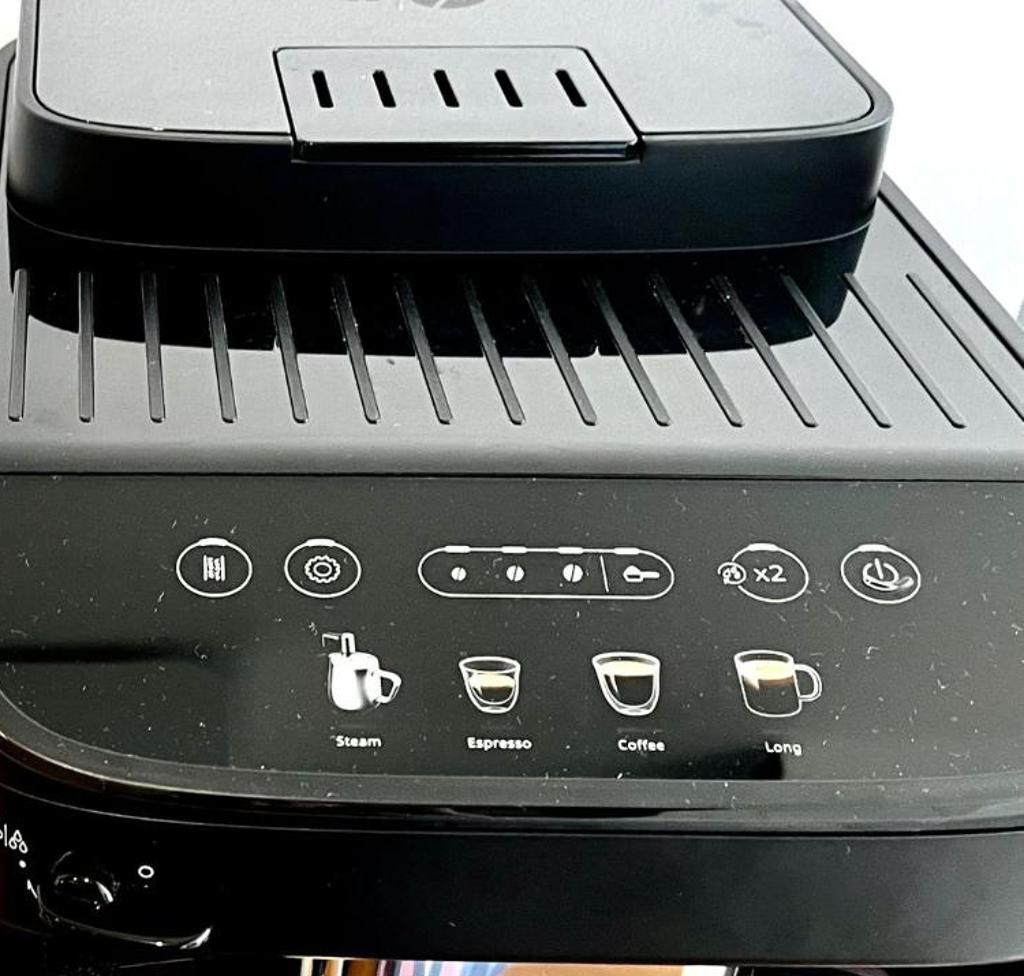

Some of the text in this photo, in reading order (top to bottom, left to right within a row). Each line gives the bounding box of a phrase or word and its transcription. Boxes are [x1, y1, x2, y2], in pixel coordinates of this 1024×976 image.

[753, 564, 787, 582] x2
[336, 735, 382, 748] Steam
[467, 736, 533, 751] Espresso
[617, 739, 666, 752] Coffee
[764, 741, 803, 756] Long
